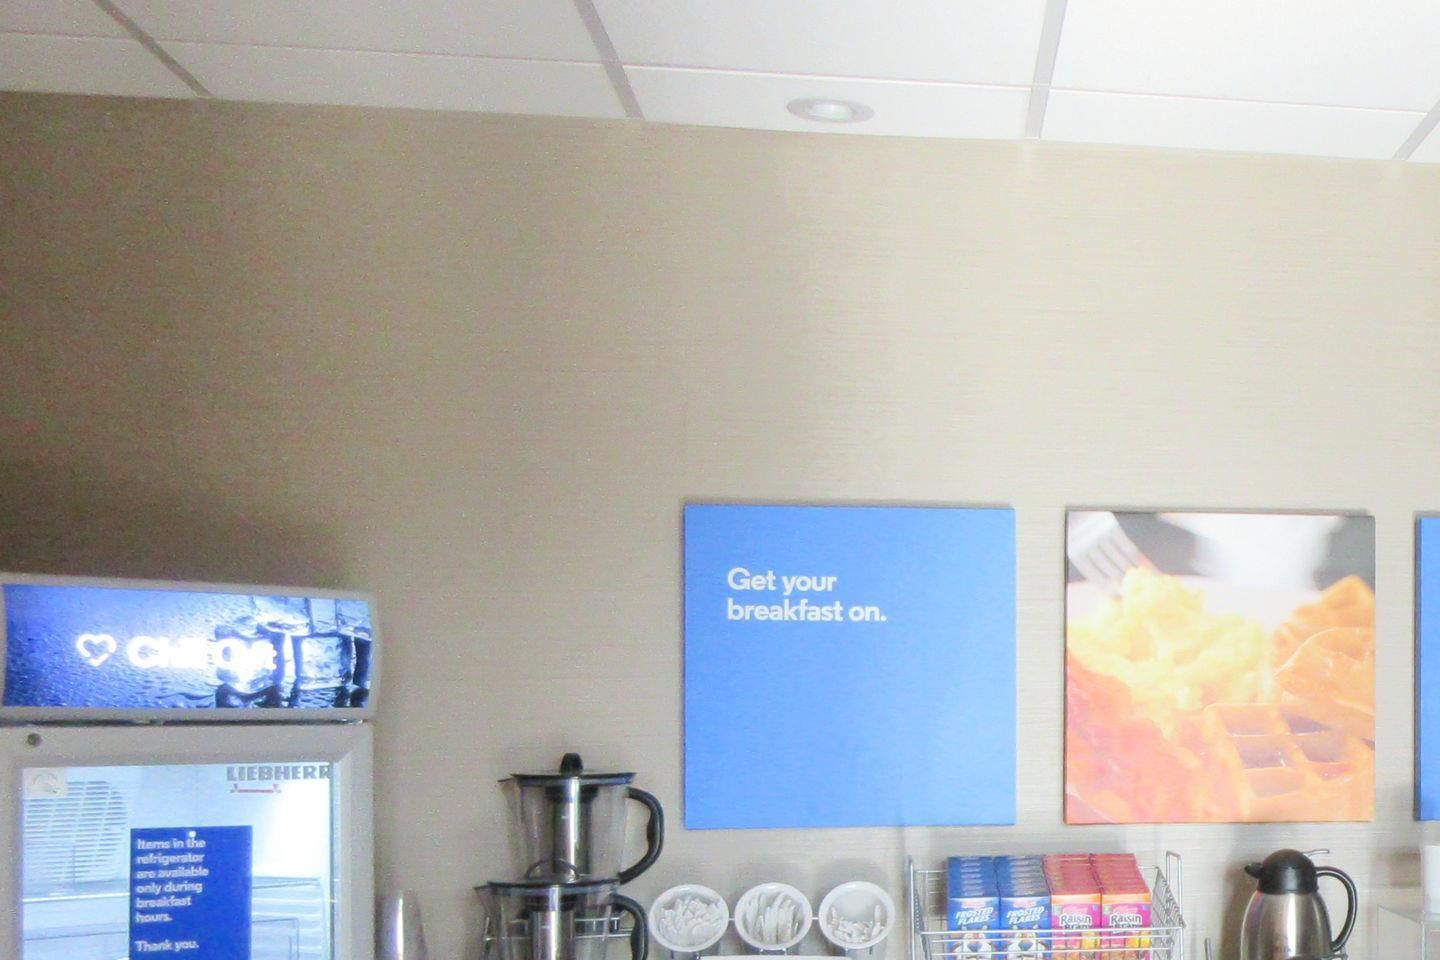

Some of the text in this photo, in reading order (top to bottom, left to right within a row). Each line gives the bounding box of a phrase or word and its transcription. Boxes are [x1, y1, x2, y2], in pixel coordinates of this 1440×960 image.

[727, 567, 838, 596] Get your
[727, 597, 888, 623] breakfast on.
[226, 765, 331, 781] LIEBHERR
[137, 837, 207, 850] Items in the
[136, 852, 206, 866] refrigerator
[136, 866, 209, 879] are available
[136, 880, 203, 895] only during
[136, 895, 192, 908] breakfast
[136, 911, 174, 924] hours.
[955, 906, 994, 919] FROSTED
[1006, 906, 1045, 919] FROSTED
[1060, 913, 1092, 926] Raisin
[1110, 913, 1142, 926] Raisin
[134, 939, 200, 953] Thank you.
